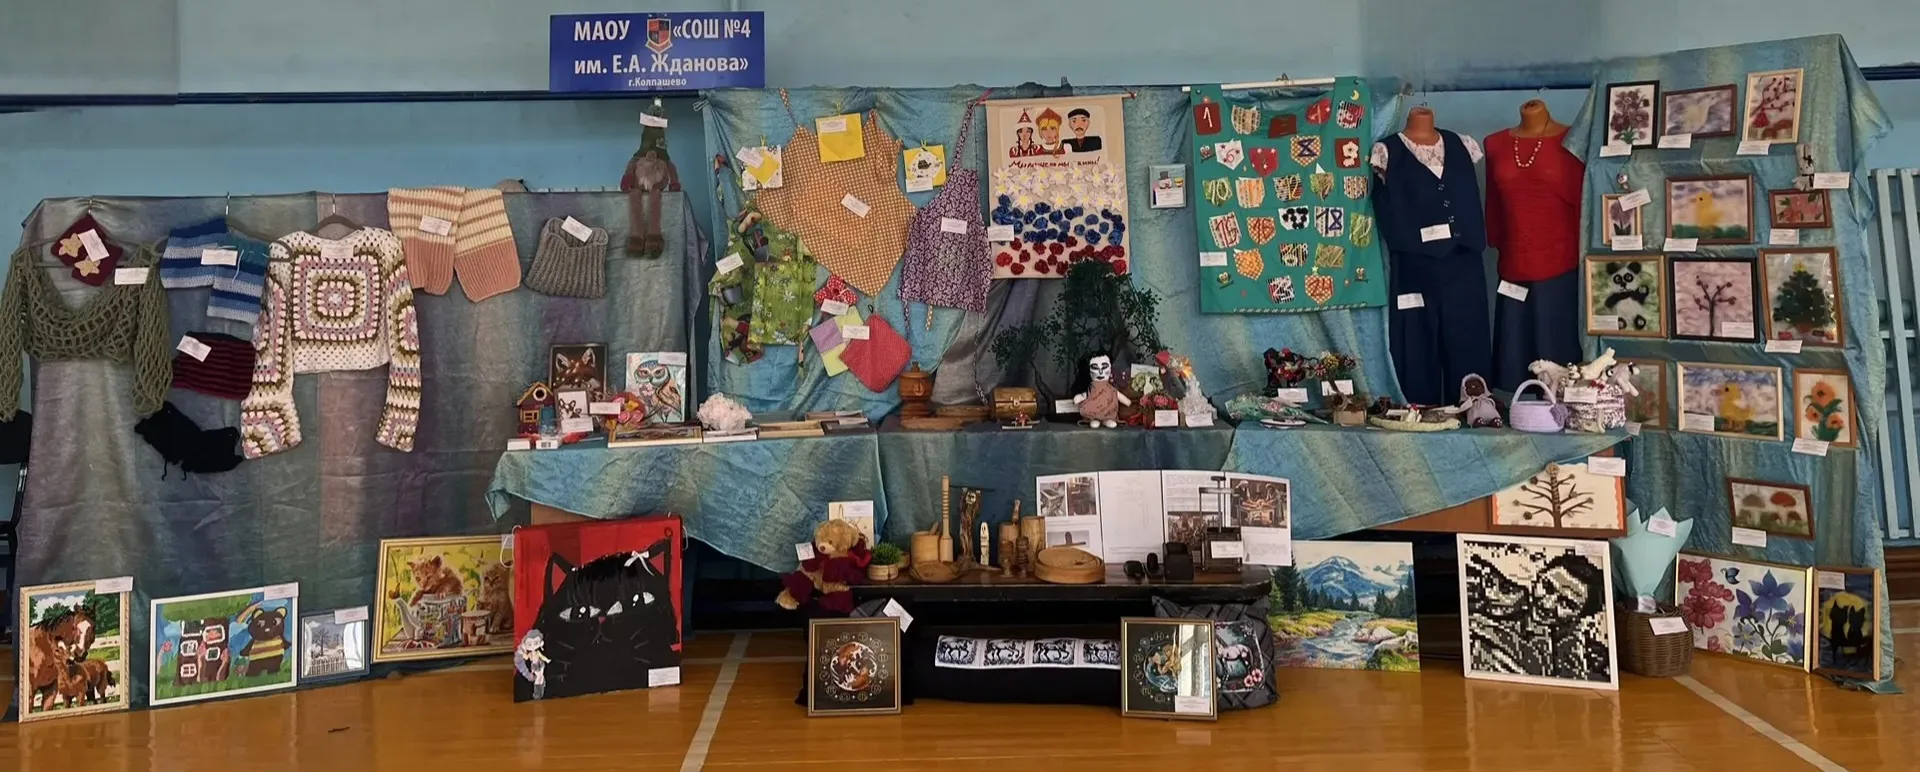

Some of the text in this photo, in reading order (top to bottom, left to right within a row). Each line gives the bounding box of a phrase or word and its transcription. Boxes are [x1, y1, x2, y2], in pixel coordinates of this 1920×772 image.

[574, 18, 751, 41] МАОУ «СОШ №4
[574, 53, 749, 75] им. Е.А. Жданова»
[628, 77, 687, 87] г.Колпашево
[1316, 208, 1343, 235] 18
